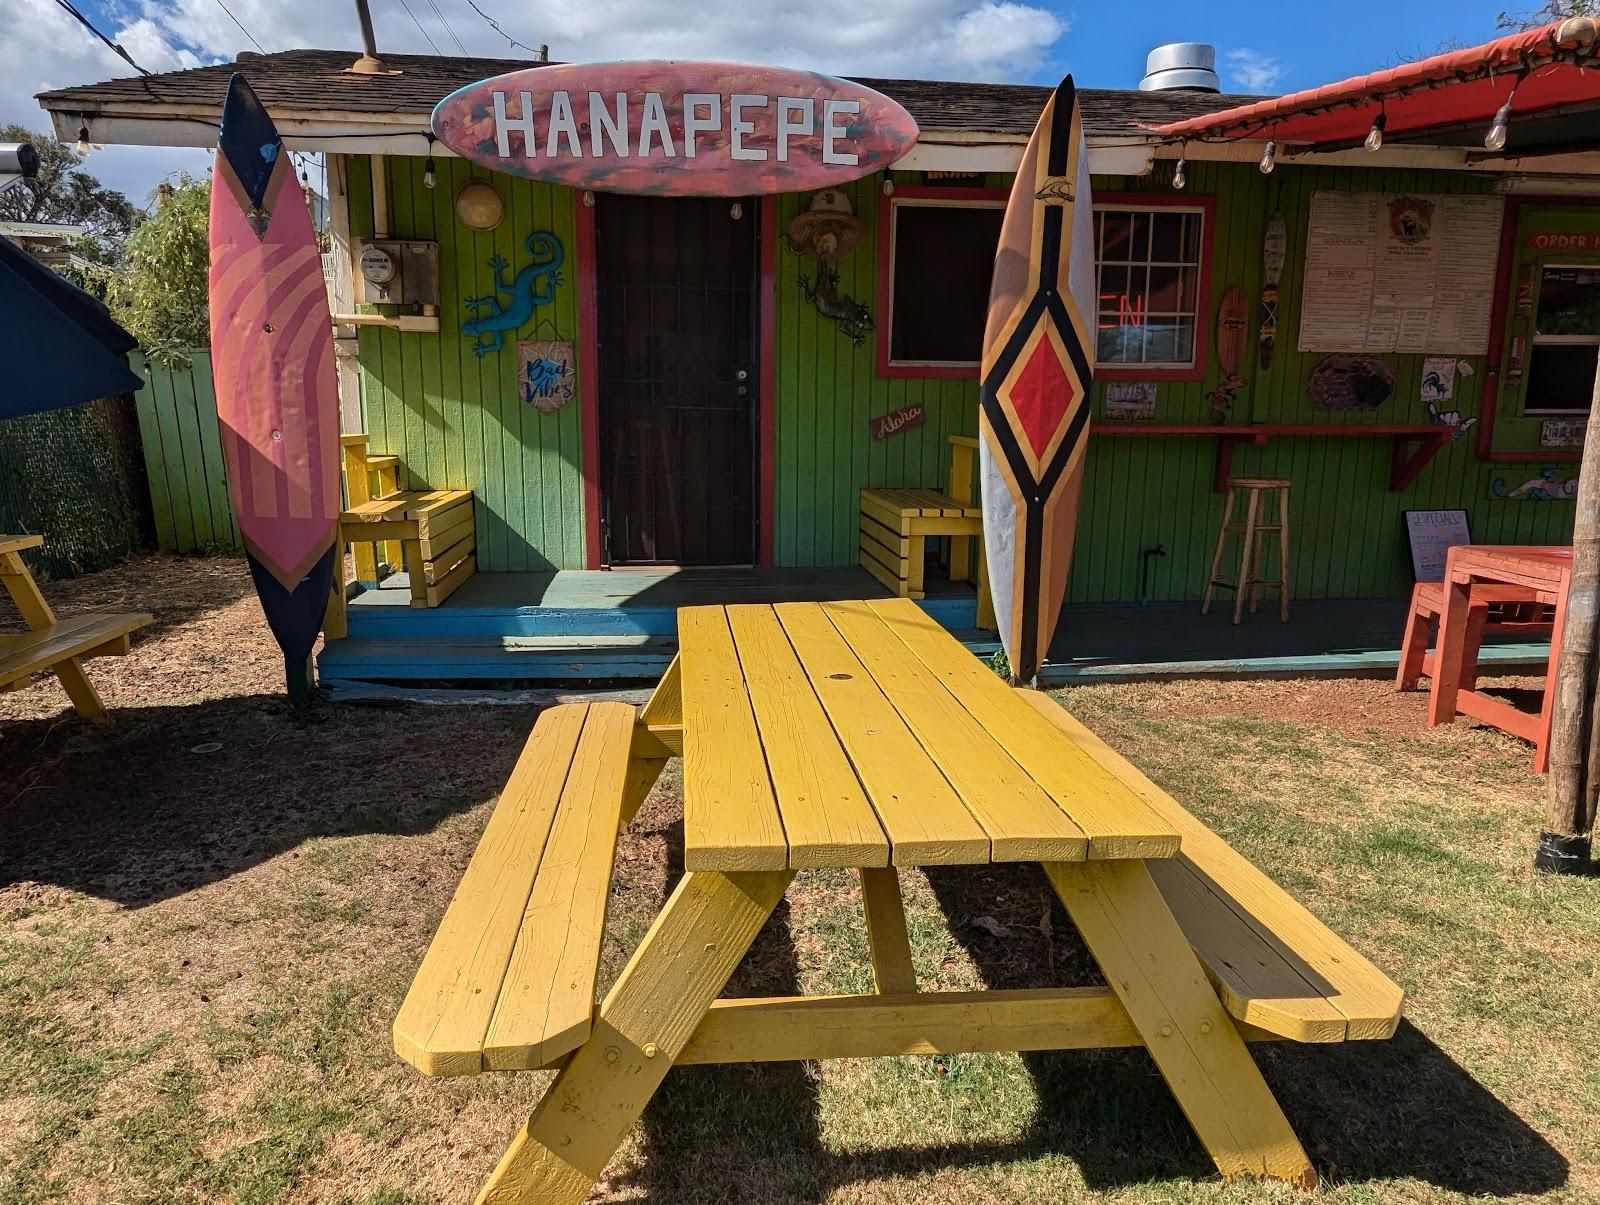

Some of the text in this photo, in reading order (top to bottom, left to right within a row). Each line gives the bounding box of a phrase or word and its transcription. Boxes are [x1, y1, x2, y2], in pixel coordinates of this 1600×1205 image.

[491, 89, 862, 166] HANAPEPE
[1535, 234, 1588, 249] ORDER
[527, 358, 568, 382] Bad
[521, 374, 572, 403] Vibes
[878, 407, 921, 438] Aloha
